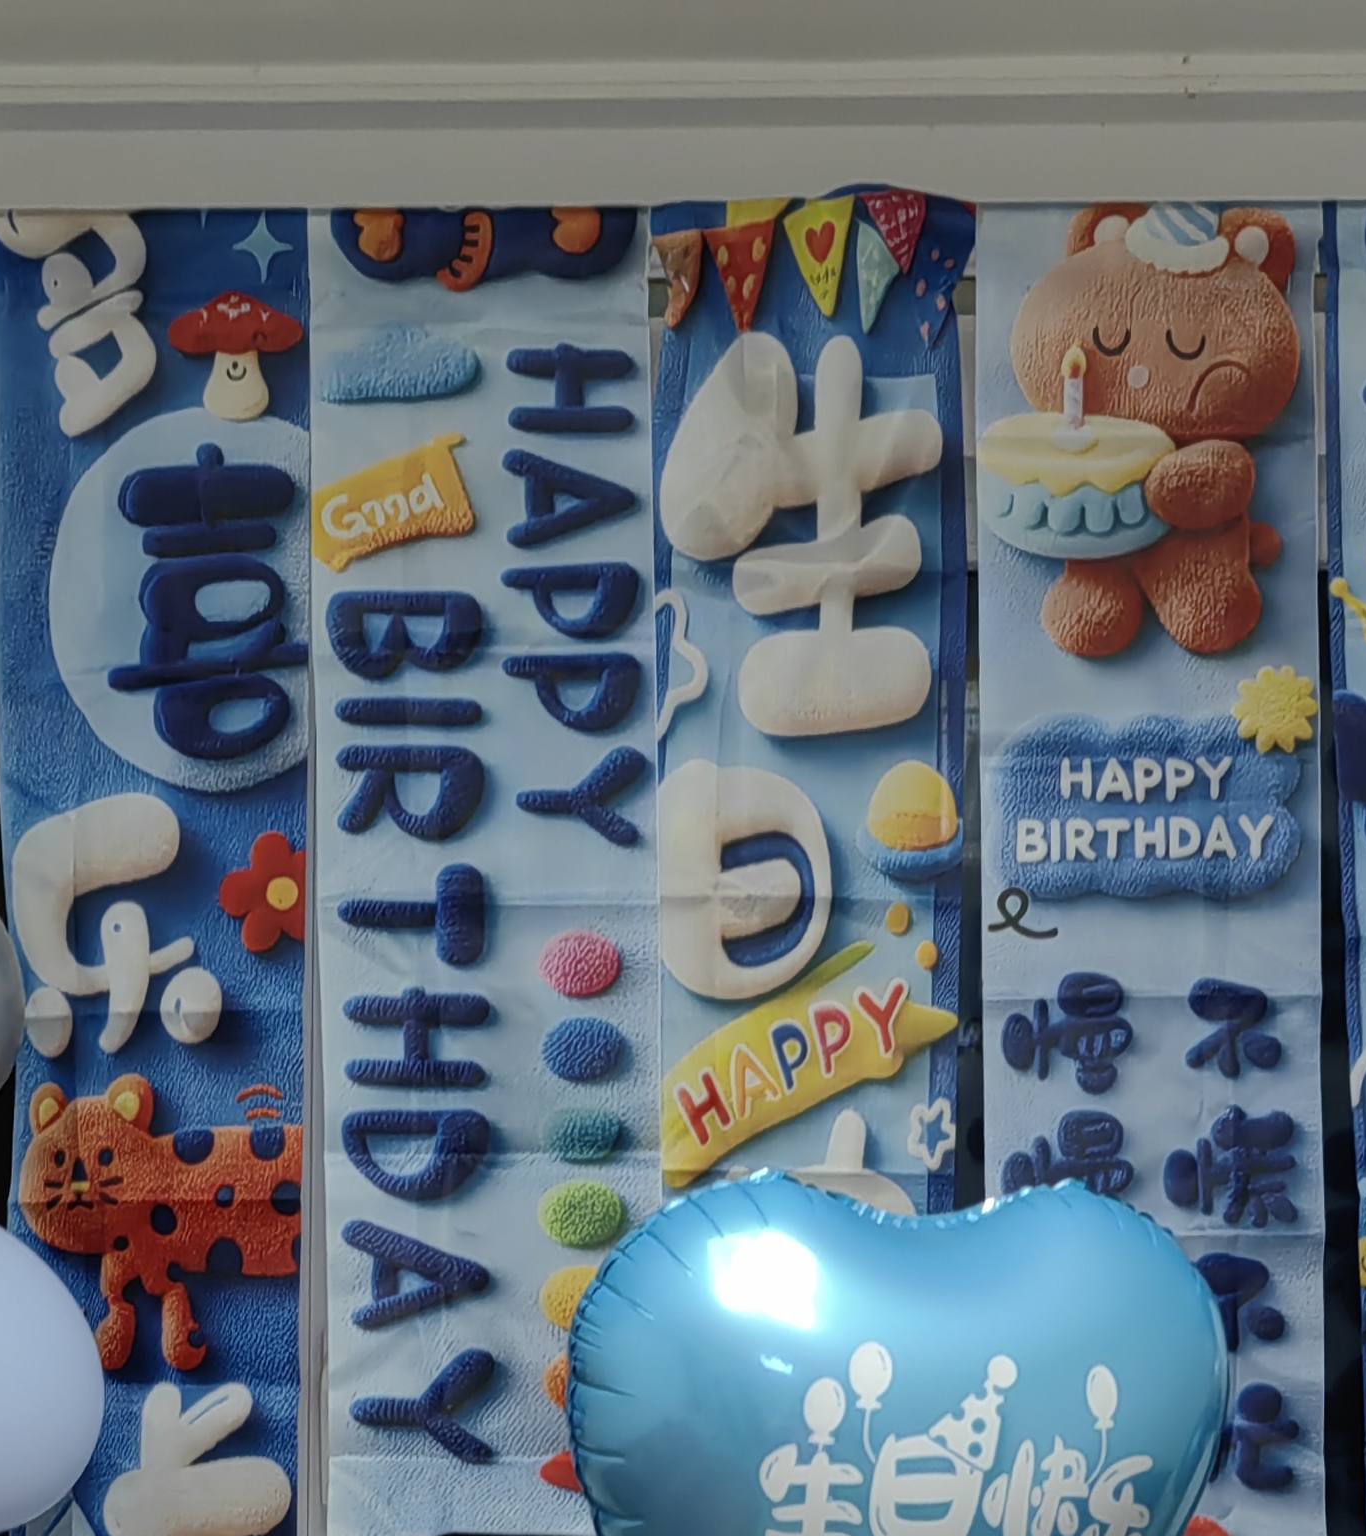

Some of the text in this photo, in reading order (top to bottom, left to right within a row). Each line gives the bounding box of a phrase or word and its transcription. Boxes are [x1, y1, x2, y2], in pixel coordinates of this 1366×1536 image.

[501, 343, 647, 847] HAPPY
[1015, 814, 1276, 864] BIRTHDAY
[1059, 755, 1233, 802] HAPPY
[325, 590, 496, 1465] BIRTHDAY
[676, 979, 911, 1148] HAPPY
